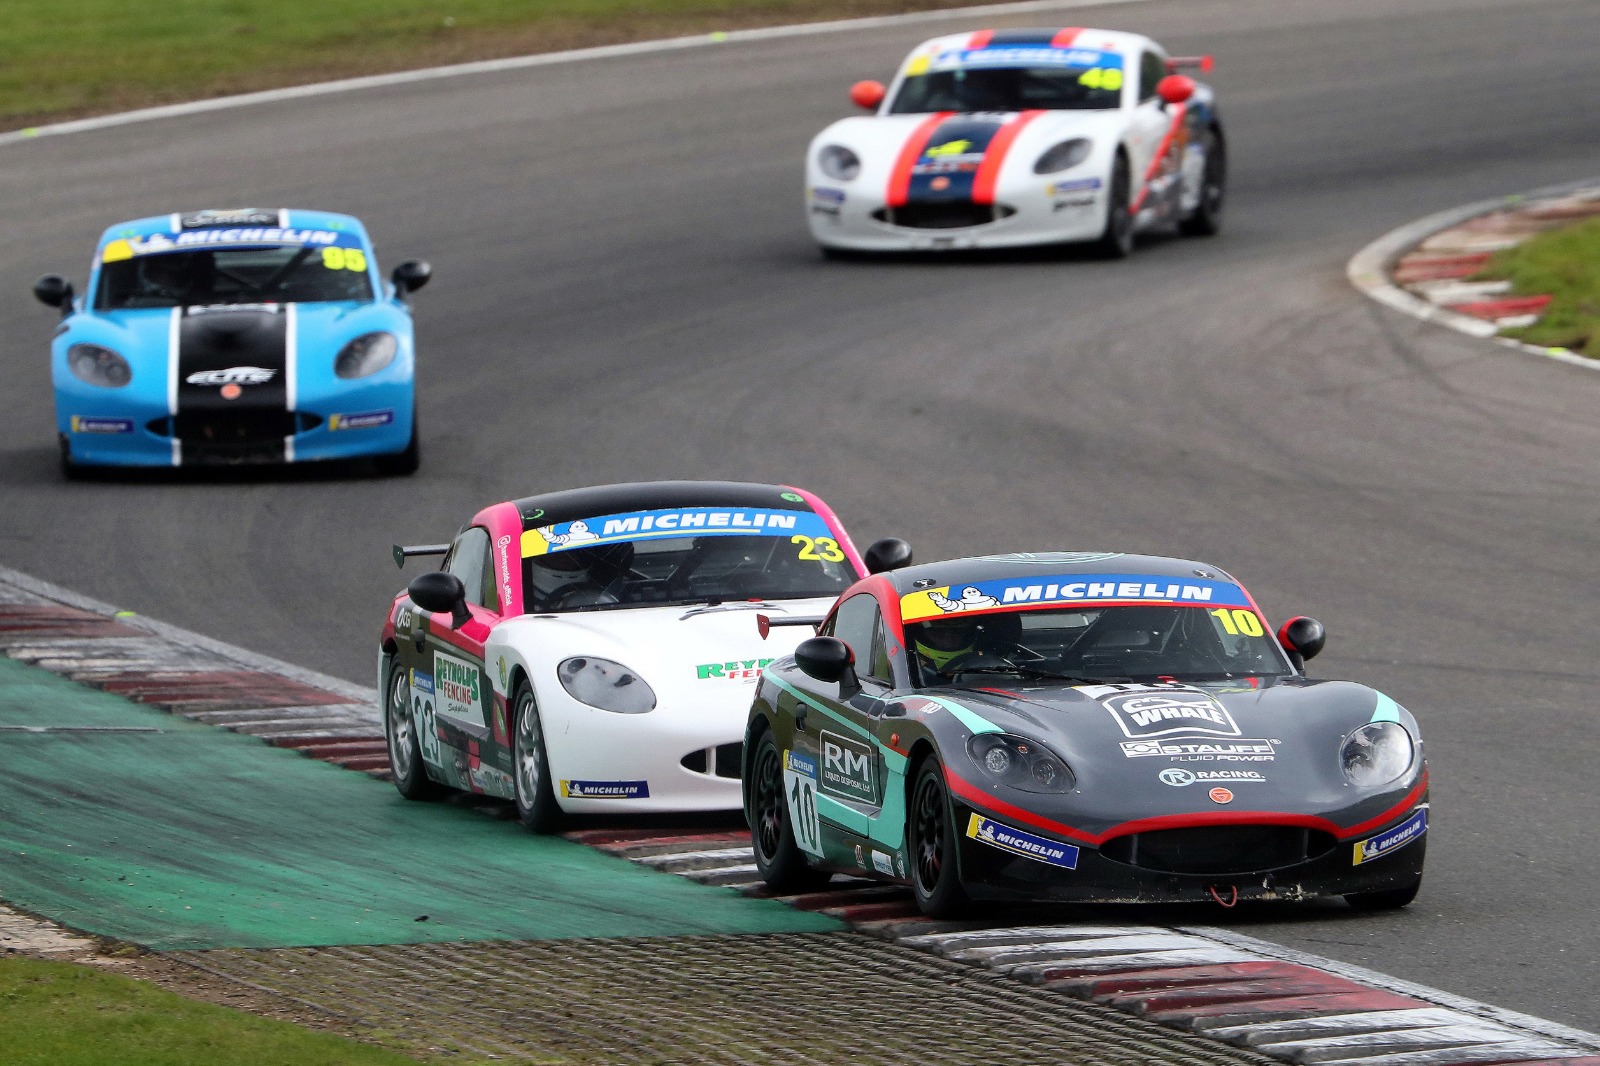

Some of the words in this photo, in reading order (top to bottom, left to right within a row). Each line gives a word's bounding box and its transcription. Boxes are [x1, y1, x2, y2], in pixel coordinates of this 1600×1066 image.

[175, 228, 338, 245] MICHELIN
[322, 246, 366, 272] 95
[603, 512, 796, 535] MICHELIN
[791, 534, 845, 563] 23
[1002, 582, 1213, 602] MICHELIN
[1210, 608, 1264, 638] 10
[436, 657, 479, 701] REYNOLDS
[695, 658, 775, 679] REYN
[443, 681, 471, 705] FENCING
[1130, 706, 1226, 727] WHALE
[414, 695, 439, 763] 23
[1161, 744, 1270, 754] STAUFF
[793, 758, 814, 774] MICHELIN
[824, 741, 869, 782] RM
[584, 786, 638, 794] MICHELIN
[825, 771, 840, 782] LIQUID
[841, 776, 862, 790] DISPOSAL
[792, 776, 817, 851] 10
[996, 832, 1065, 859] MICHELIN
[1380, 820, 1421, 850] MICHELIN
